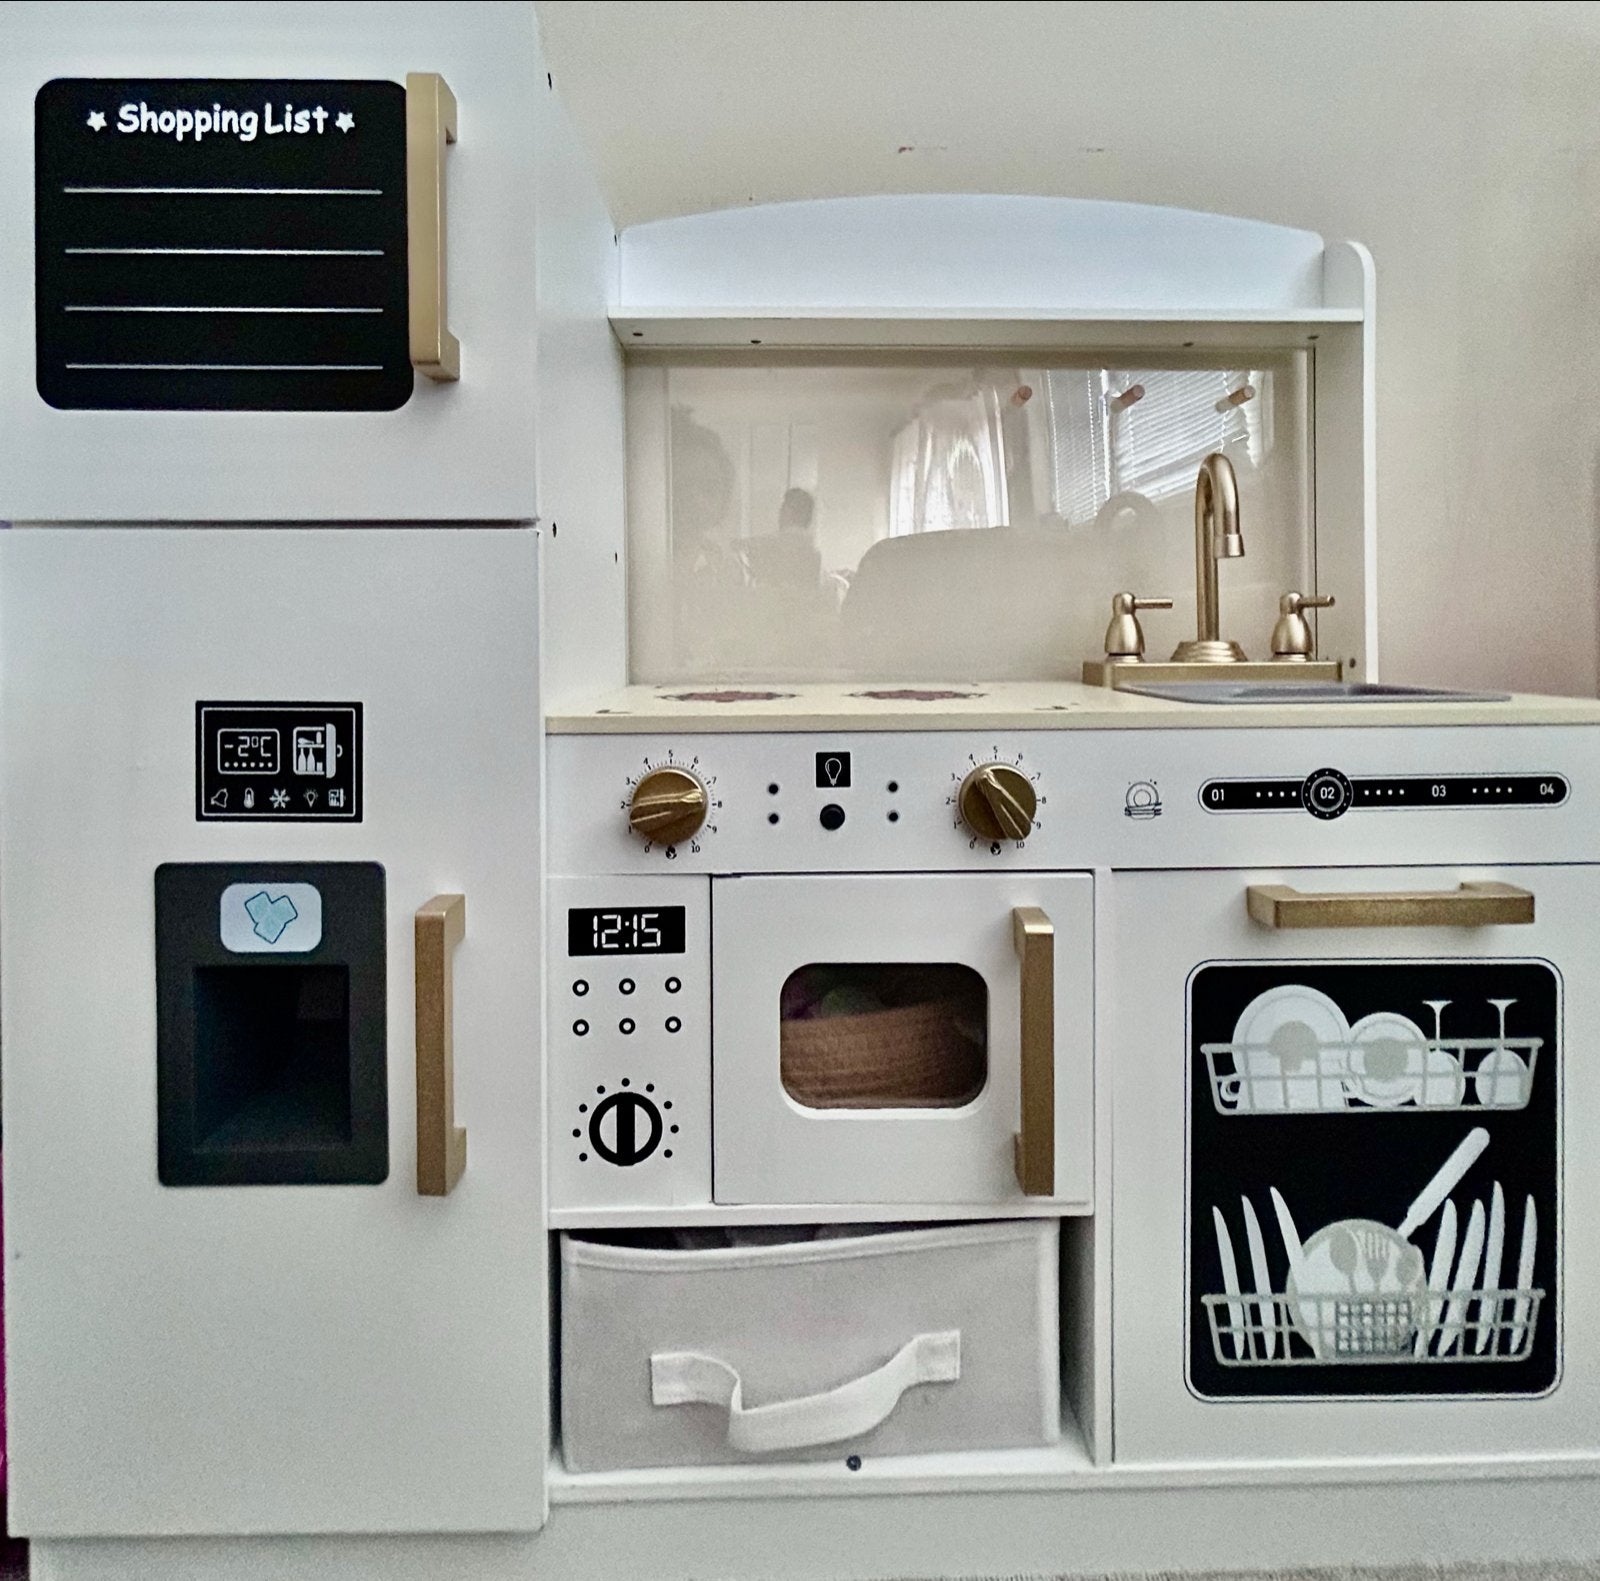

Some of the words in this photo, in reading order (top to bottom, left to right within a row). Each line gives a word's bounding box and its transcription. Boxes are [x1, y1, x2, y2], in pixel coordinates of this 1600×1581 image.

[117, 101, 258, 141] Shopping
[264, 103, 328, 133] List
[1211, 788, 1225, 801] 01
[1320, 787, 1335, 799] 02
[1431, 784, 1446, 797] 03
[1540, 783, 1555, 795] 04
[691, 845, 700, 853] 10
[1016, 841, 1025, 849] 10
[593, 913, 661, 949] 12:15
